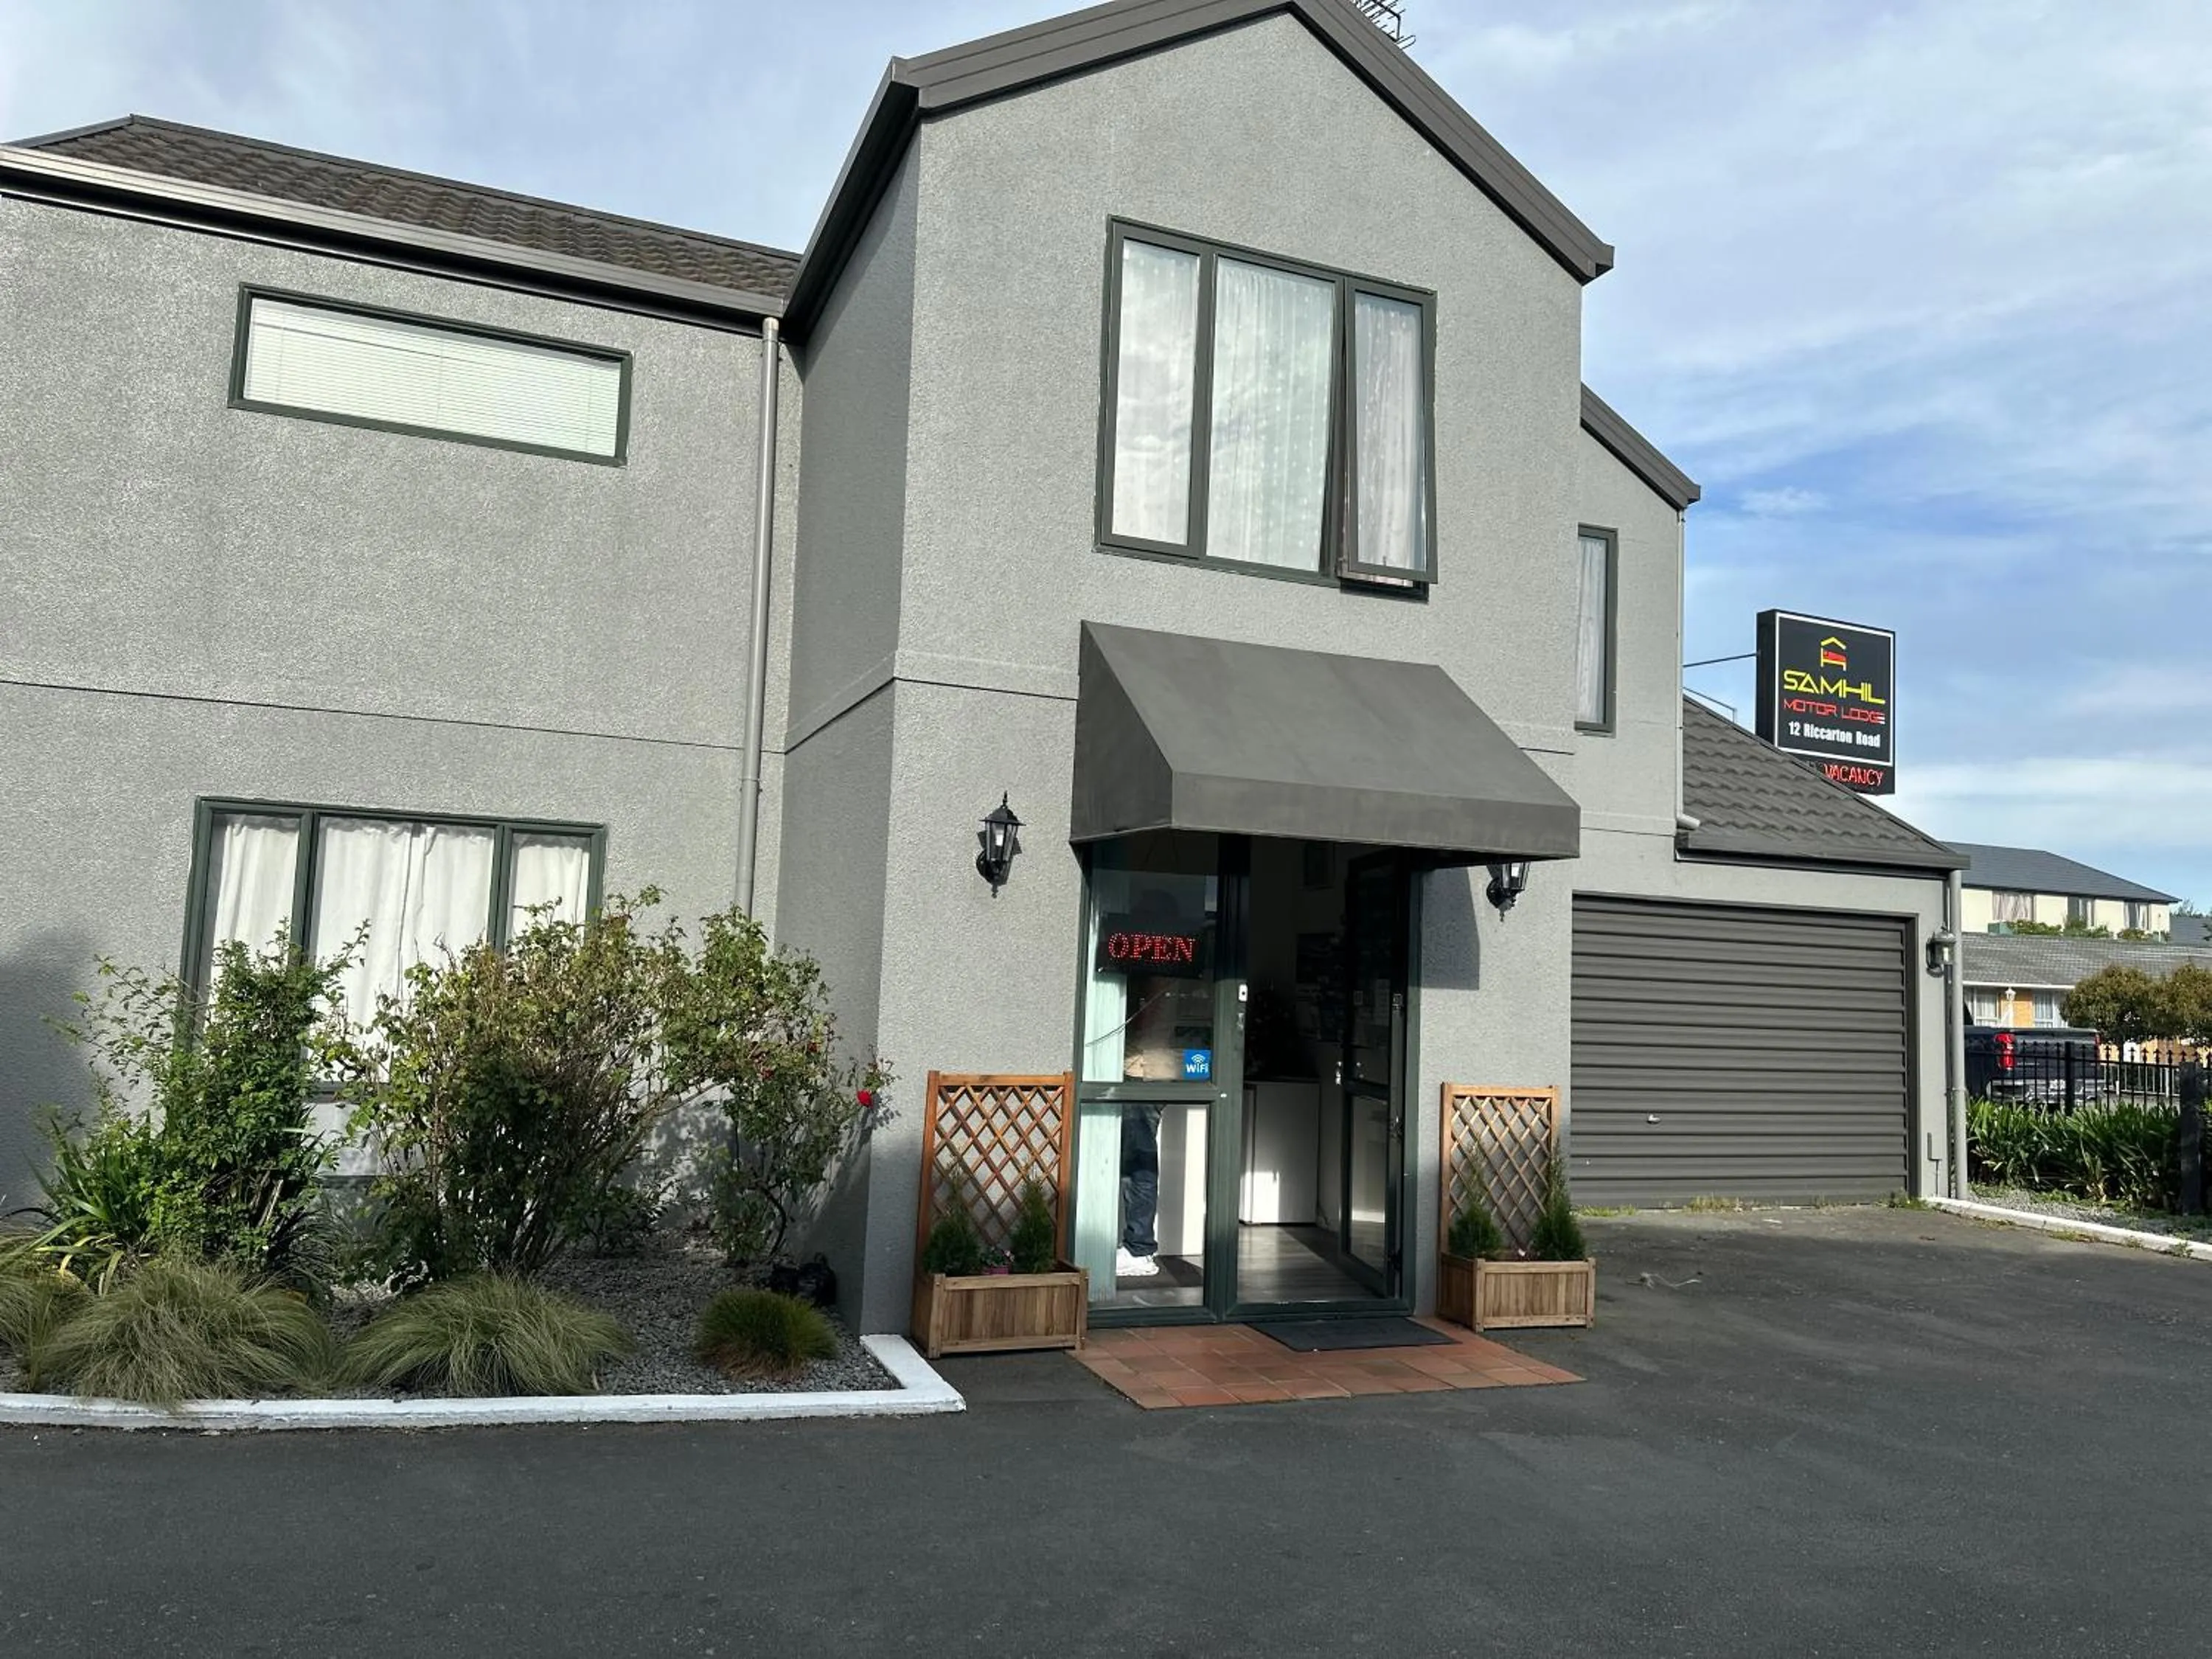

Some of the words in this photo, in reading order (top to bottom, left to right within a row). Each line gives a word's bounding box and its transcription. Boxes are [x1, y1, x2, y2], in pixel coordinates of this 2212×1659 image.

[1784, 669, 1886, 704] SAMHIL
[1783, 698, 1837, 717] MOTOR
[1841, 706, 1885, 724] LODGE
[1788, 720, 1801, 737] 12
[1803, 723, 1853, 744] Riccarton
[1856, 731, 1881, 748] Road
[1823, 762, 1884, 787] VACANCY
[1108, 932, 1196, 962] OPEN
